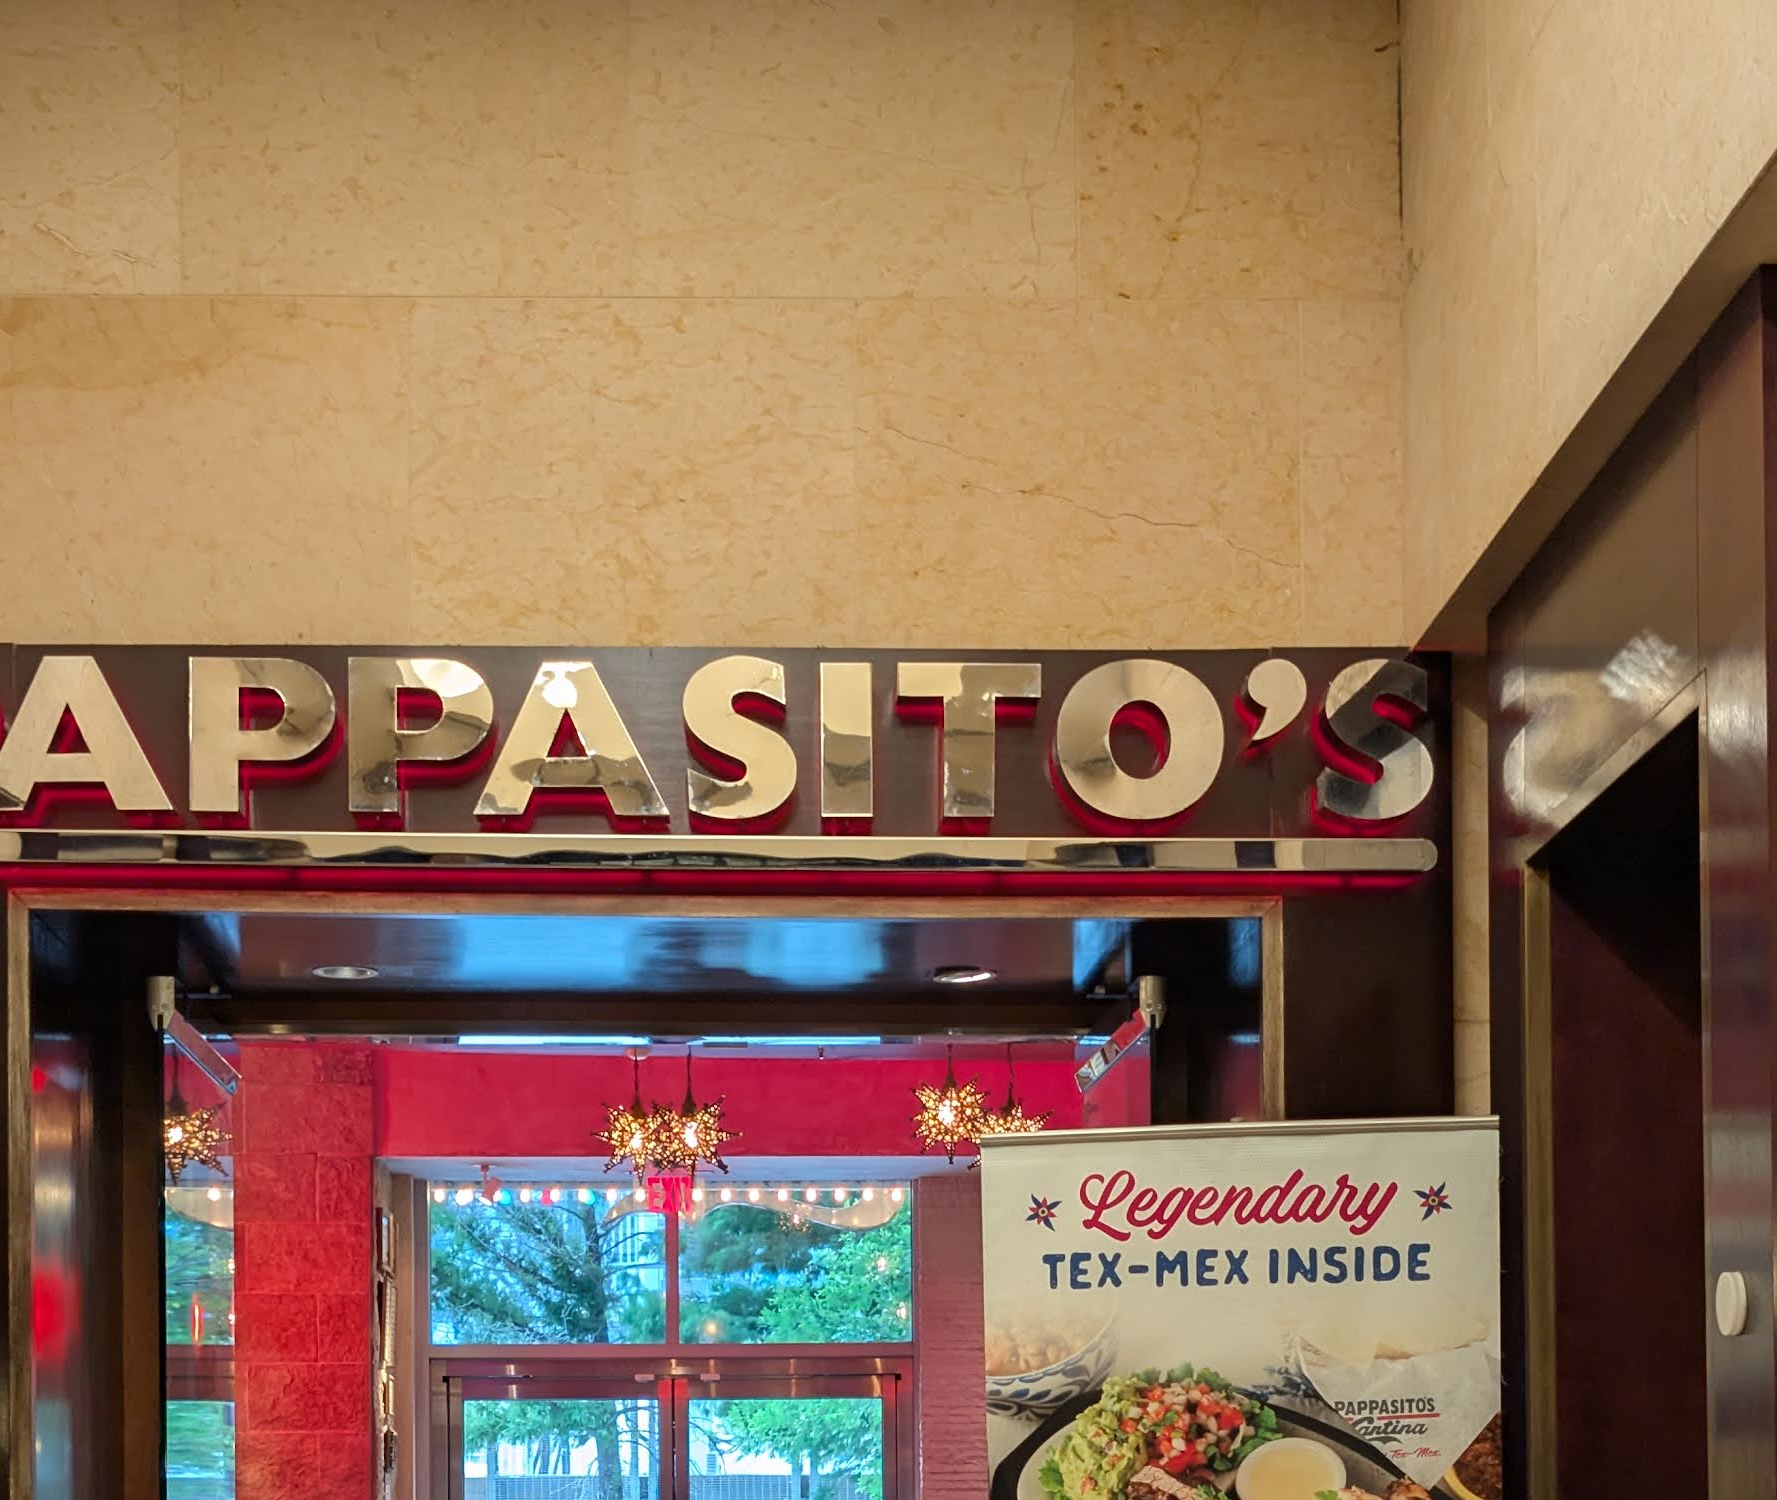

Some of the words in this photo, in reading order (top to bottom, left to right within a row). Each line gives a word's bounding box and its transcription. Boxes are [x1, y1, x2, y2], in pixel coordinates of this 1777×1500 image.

[647, 1177, 692, 1211] EXIT
[1079, 1169, 1399, 1242] Legendary
[1042, 1249, 1250, 1290] TEX-MEX
[1268, 1243, 1431, 1285] INSIDE
